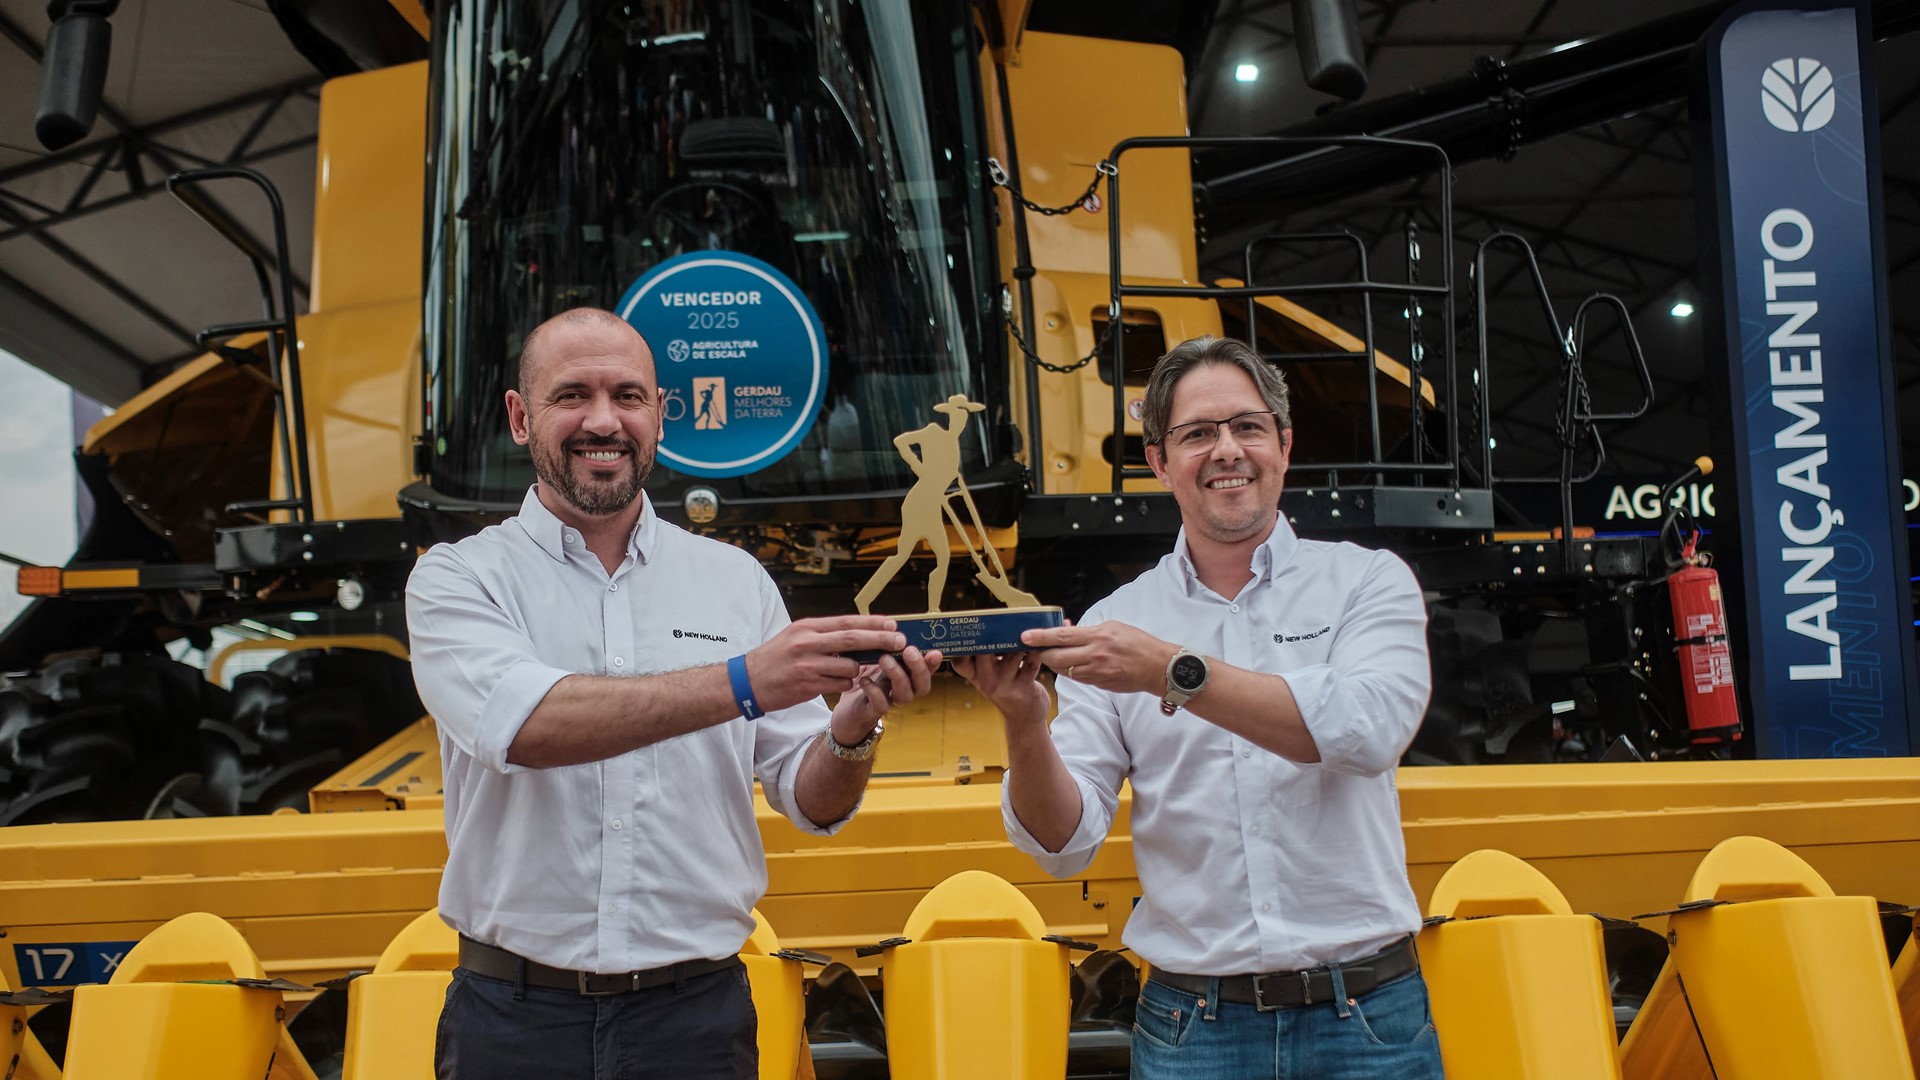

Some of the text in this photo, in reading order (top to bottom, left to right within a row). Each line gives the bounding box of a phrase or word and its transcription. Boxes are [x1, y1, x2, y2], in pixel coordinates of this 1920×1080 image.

[660, 291, 762, 307] VENCEDOR
[687, 311, 740, 330] 2025
[692, 340, 759, 350] AGRICULTURA
[692, 350, 747, 360] DE ESCALA
[733, 386, 782, 397] GERDAU
[734, 396, 792, 408] MELHORES
[1761, 208, 1844, 681] LANÇAMENTO
[949, 616, 979, 625] GERDAU
[949, 623, 986, 632] MELHORES
[684, 631, 728, 643] NEW HOLLAND
[1285, 626, 1330, 643] NEW HOLLAND
[950, 645, 987, 653] AGRICULTURA
[25, 948, 75, 980] 17
